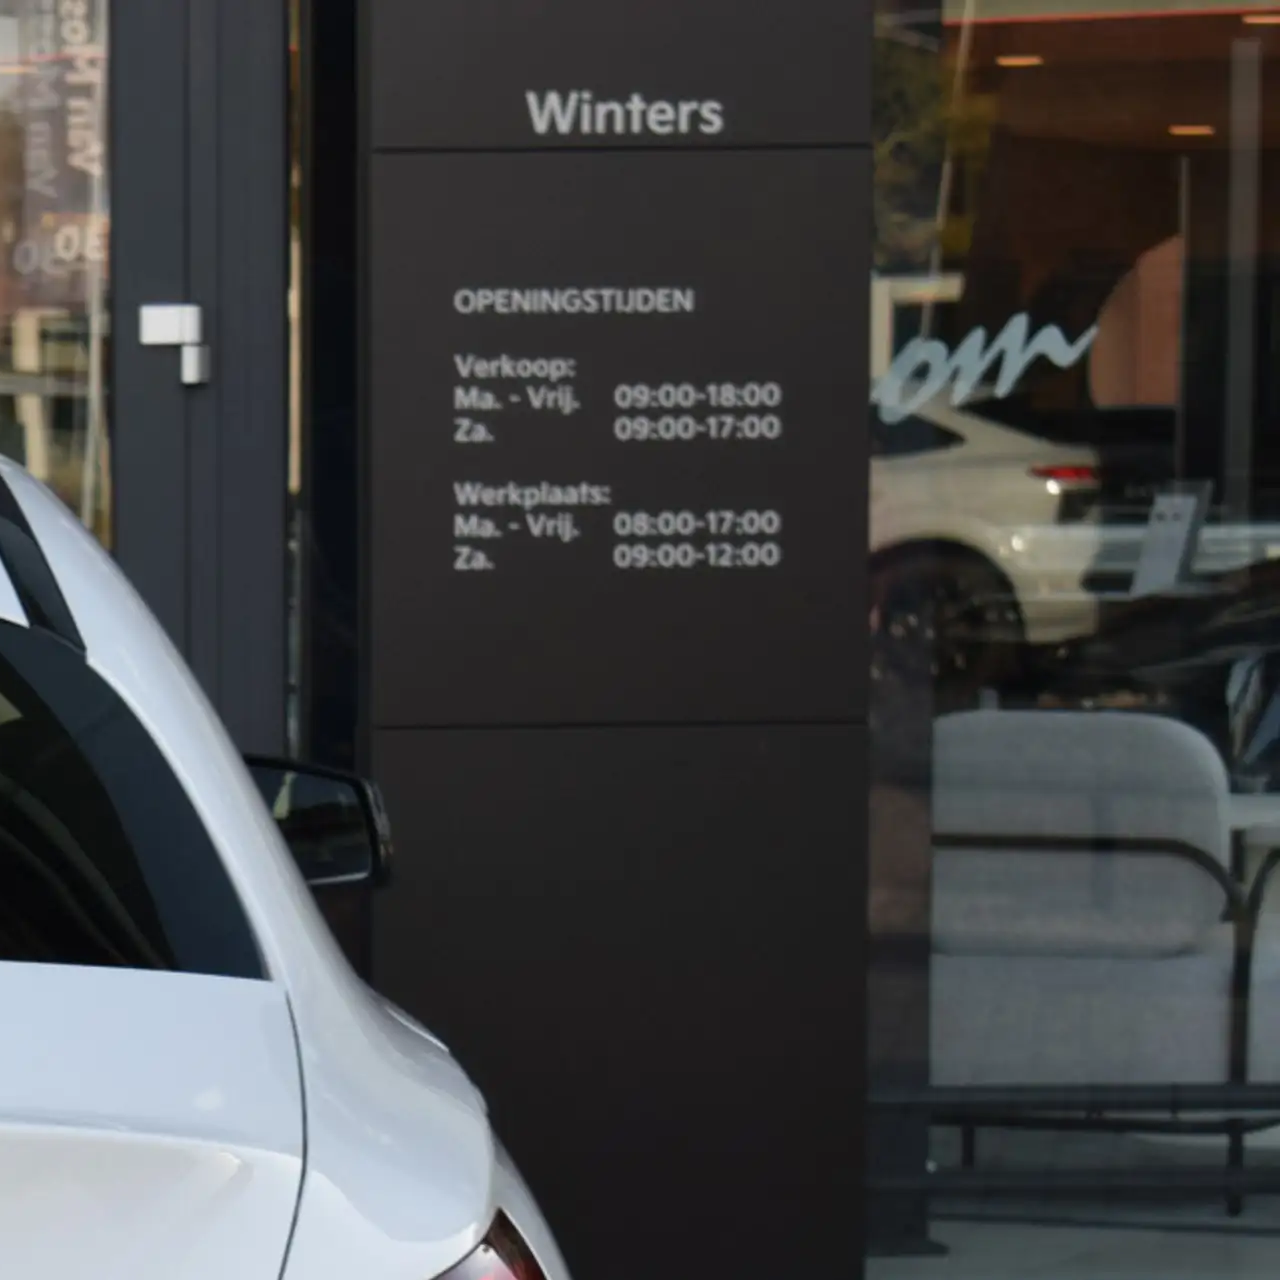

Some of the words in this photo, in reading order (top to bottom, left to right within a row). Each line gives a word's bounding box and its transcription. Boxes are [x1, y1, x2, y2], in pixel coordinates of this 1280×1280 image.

[525, 90, 724, 136] Winters
[453, 289, 694, 314] OPENINGSTIJDEN
[454, 354, 576, 381] Verkoop:
[454, 386, 502, 410] Ma.
[526, 385, 580, 415] Vrij.
[613, 382, 782, 409] 09:00-18:00
[454, 418, 494, 442] Za.
[613, 415, 782, 441] 09:00-17:00
[453, 482, 611, 510] Werkplaats:
[454, 514, 502, 538] Ma.
[526, 513, 580, 543] Vrij.
[612, 509, 781, 537] 08:00-17:00
[454, 545, 494, 570] Za.
[612, 542, 781, 569] 09:00-12:00
